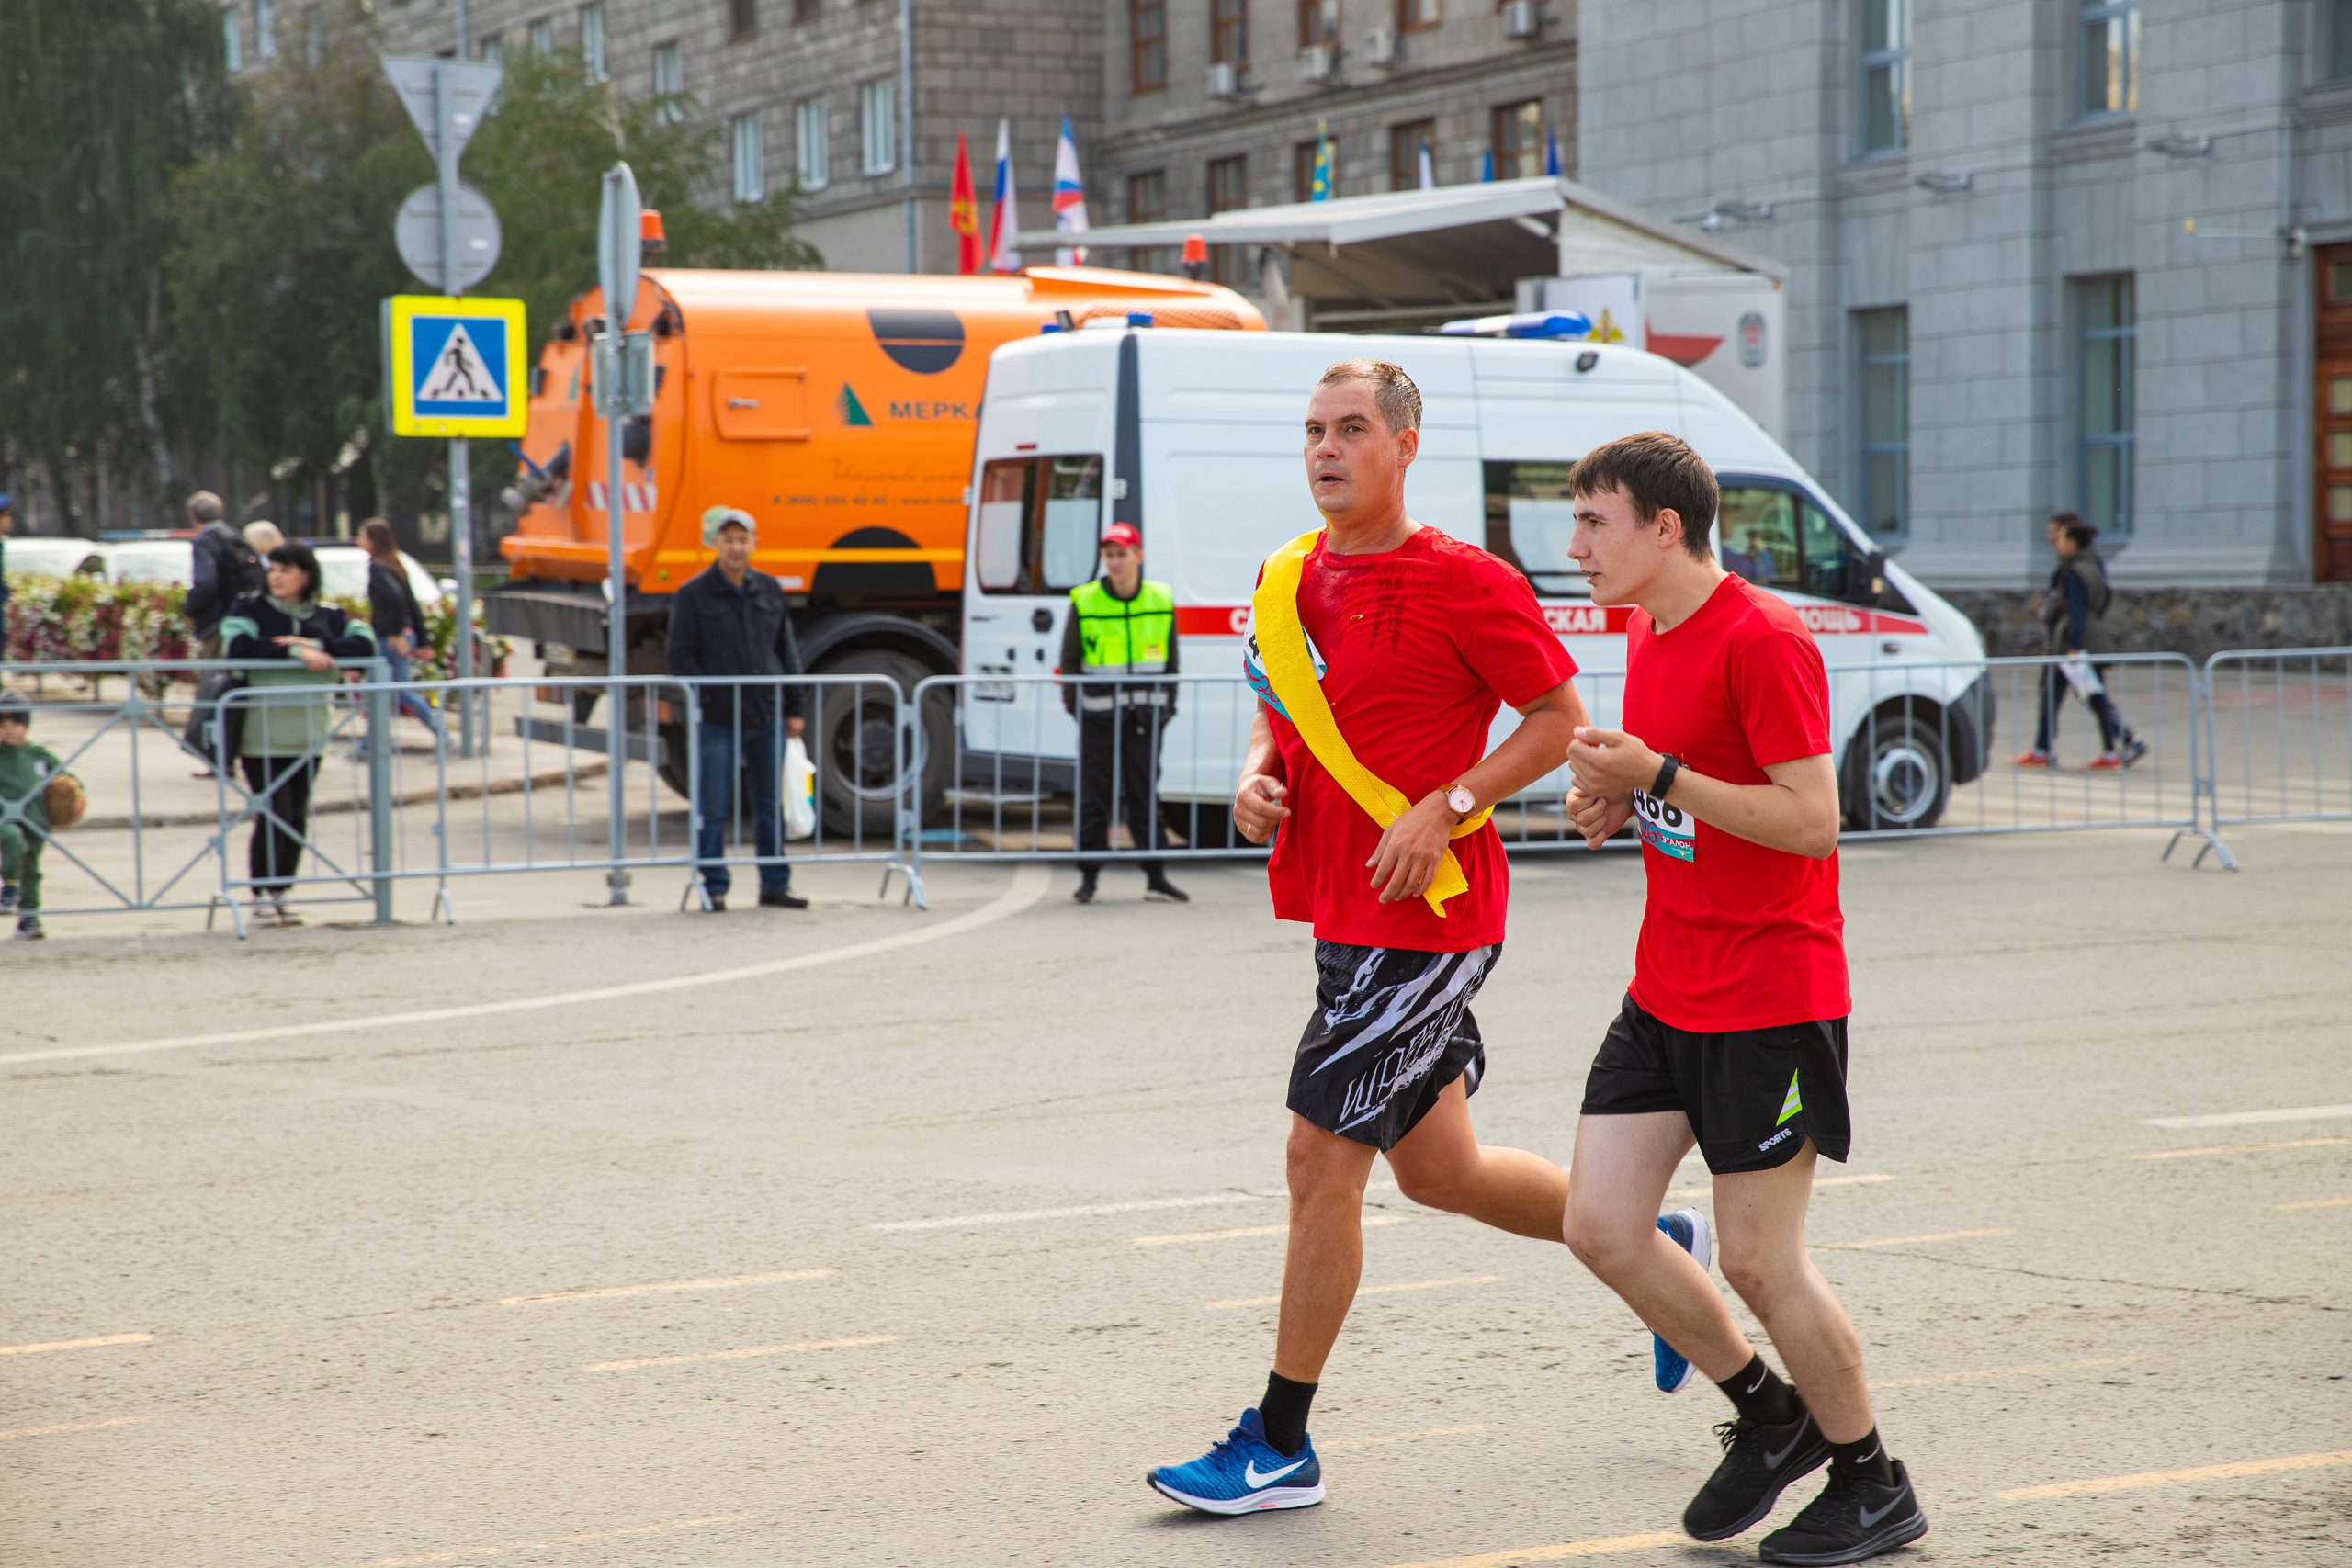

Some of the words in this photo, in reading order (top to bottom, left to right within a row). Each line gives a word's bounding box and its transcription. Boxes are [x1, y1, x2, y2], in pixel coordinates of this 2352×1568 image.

[1543, 607, 1607, 633] СКАЯ
[1633, 787, 1683, 828] 466
[1661, 835, 1692, 851] ЭТАЛОН
[1758, 1127, 1792, 1152] SPORTS
